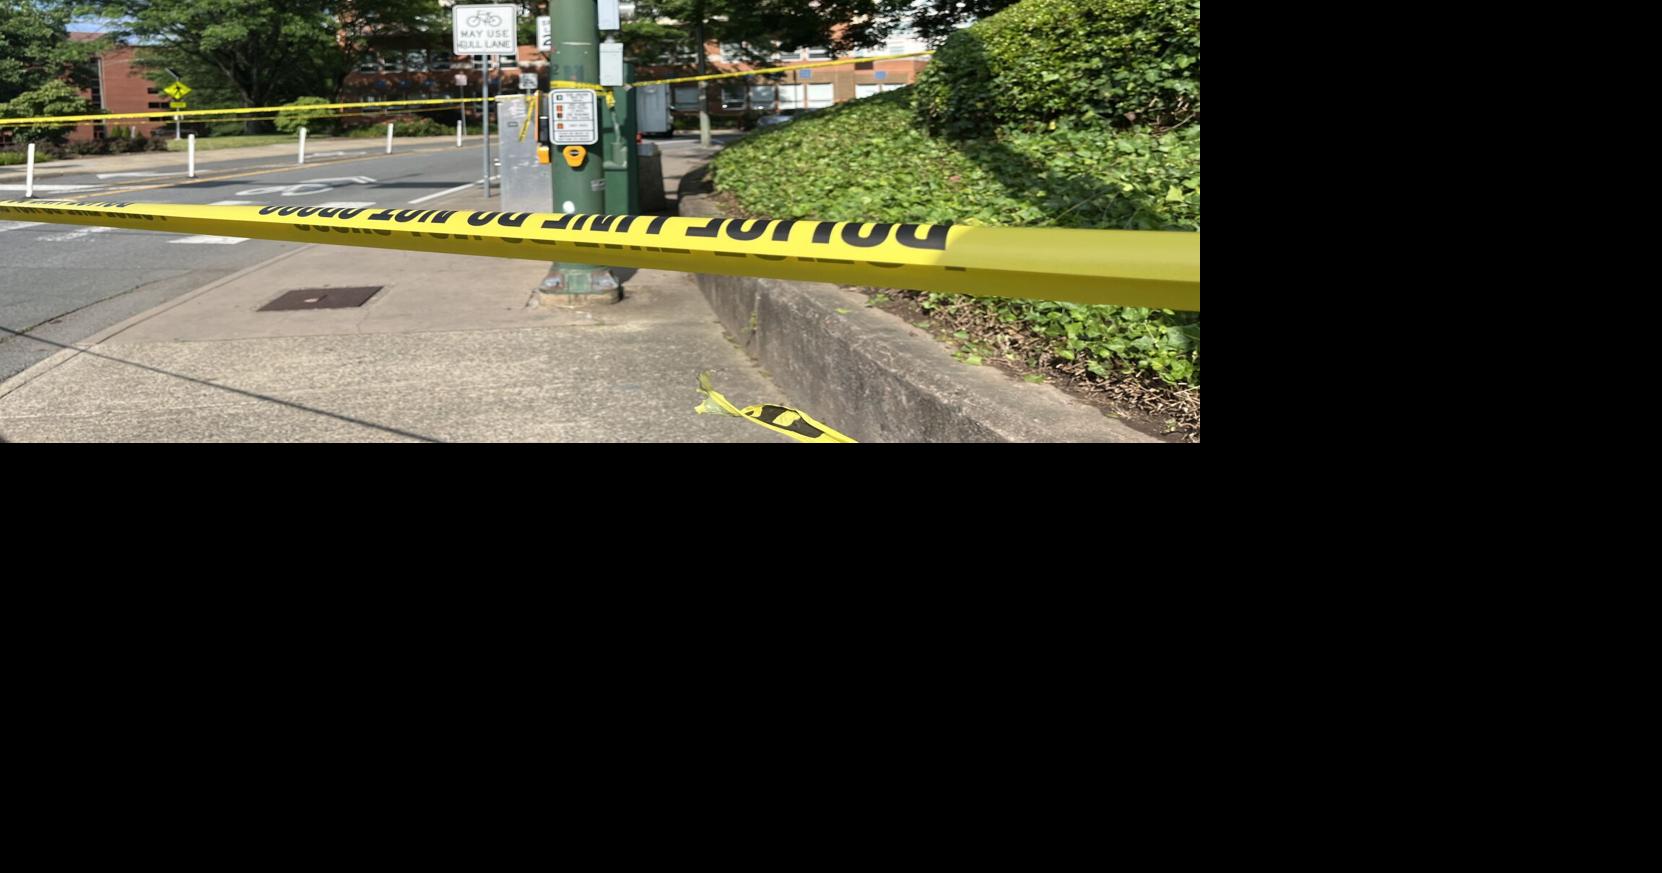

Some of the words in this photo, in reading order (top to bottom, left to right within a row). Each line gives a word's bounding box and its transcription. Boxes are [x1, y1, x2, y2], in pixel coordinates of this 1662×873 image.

[461, 30, 482, 38] MAY
[487, 30, 510, 38] USE
[484, 40, 512, 49] LANE
